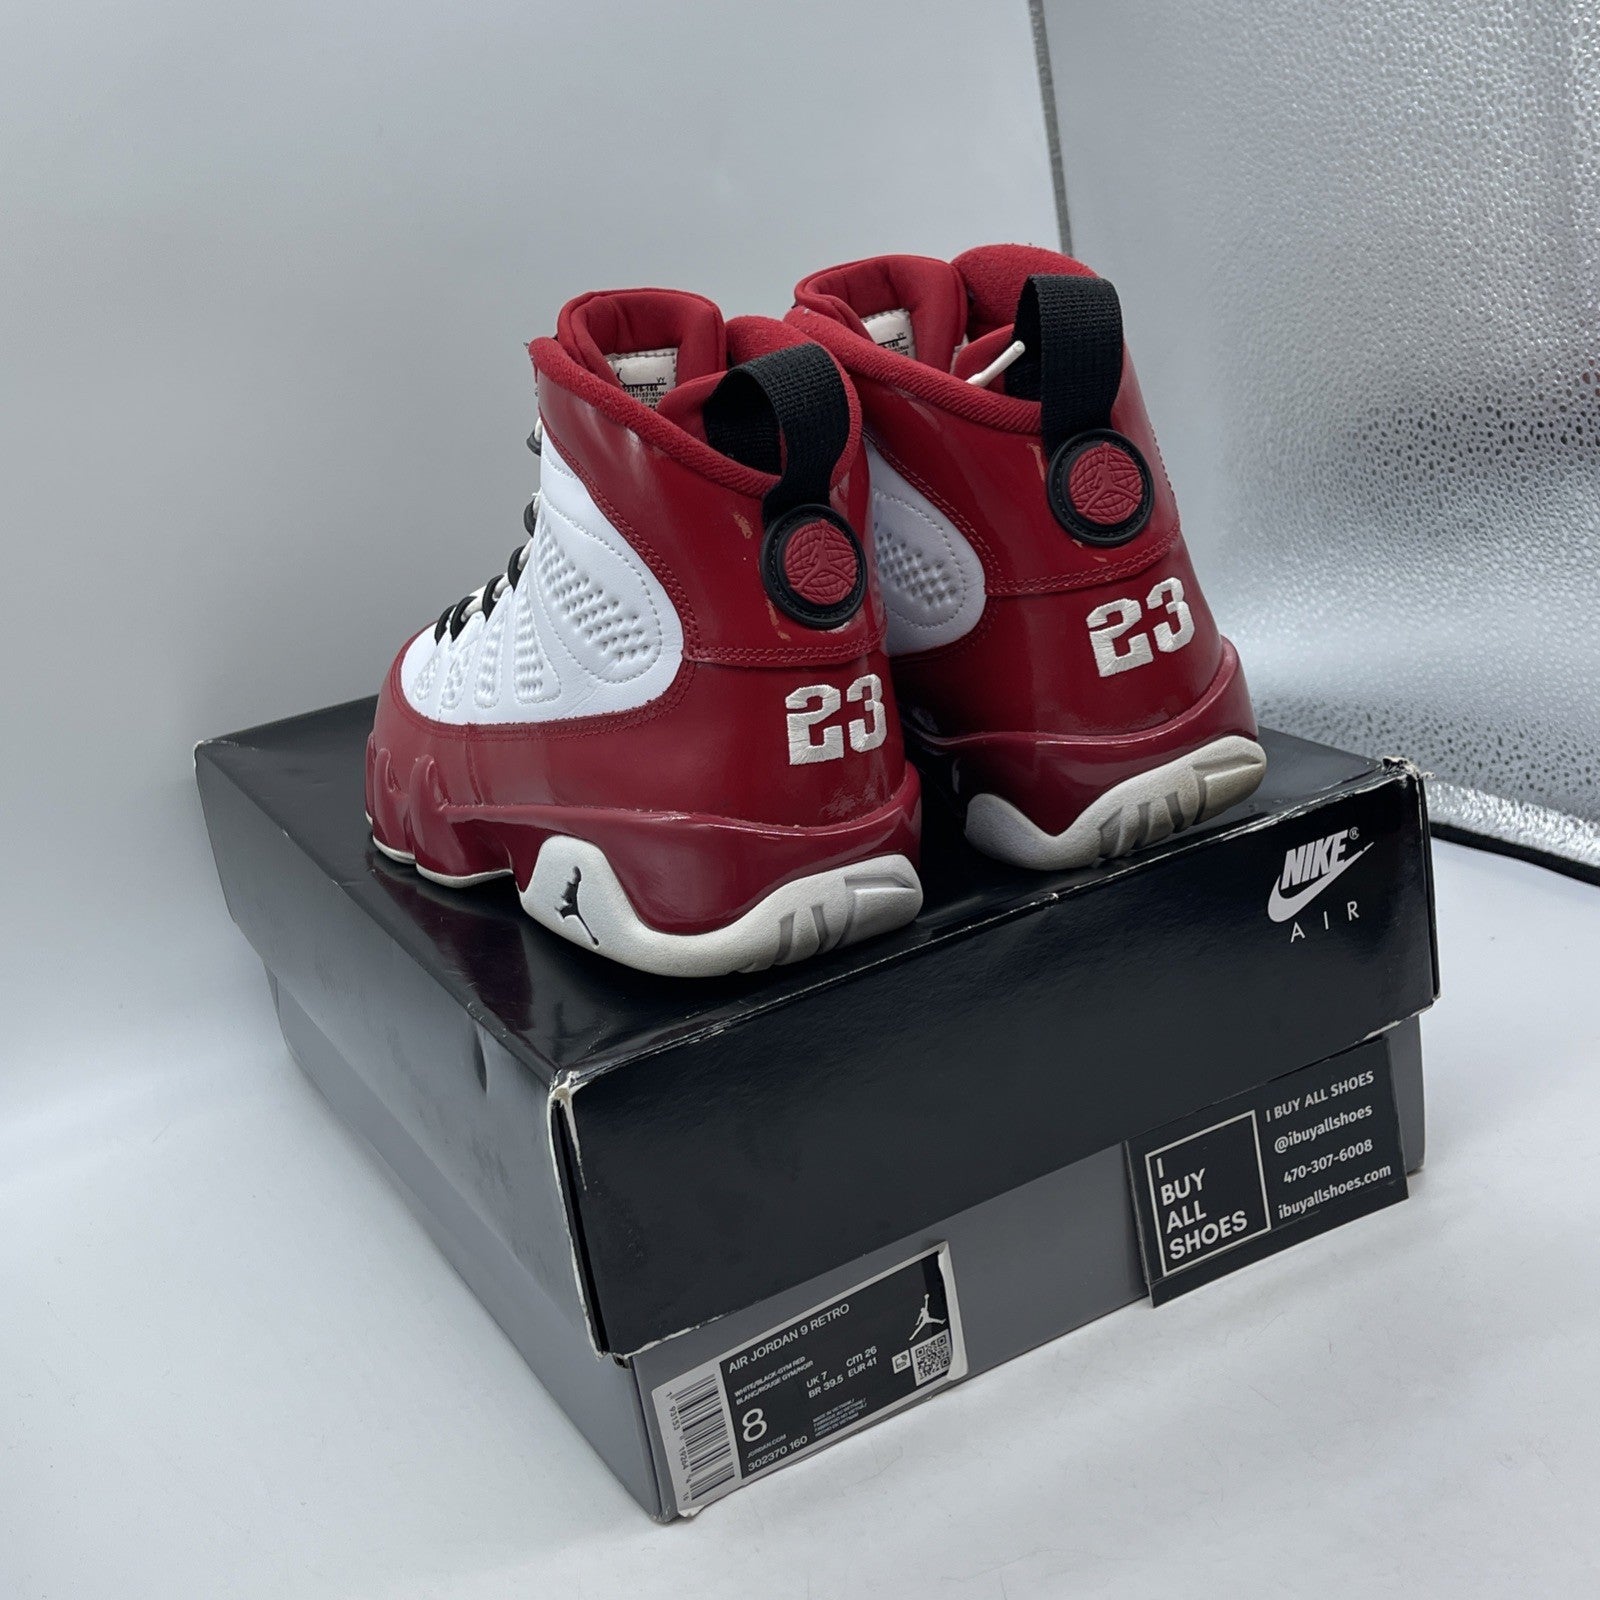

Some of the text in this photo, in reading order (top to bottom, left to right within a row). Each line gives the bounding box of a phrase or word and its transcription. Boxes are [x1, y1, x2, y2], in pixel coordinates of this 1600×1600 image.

[1085, 577, 1195, 678] 23
[785, 673, 888, 766] 23
[1280, 829, 1348, 890] NIKE
[1290, 900, 1360, 943] AIR
[1265, 1070, 1375, 1123] I BUY ALL SHOES
[1274, 1104, 1373, 1155] @ibuyallshoes
[1156, 1157, 1164, 1179] I
[1283, 1138, 1373, 1184] 470-307-6008
[1160, 1168, 1206, 1206] BUY
[1278, 1164, 1392, 1220] ibuyallshoes.com
[1166, 1200, 1207, 1234] ALL
[1169, 1210, 1248, 1260] SHOES
[729, 1303, 850, 1374] AIR JORDAN 9 RETRO
[845, 1346, 878, 1367] cm 26
[792, 1356, 806, 1368] RED
[806, 1371, 828, 1388] UK 7
[847, 1357, 877, 1378] EUR 41
[808, 1374, 844, 1399] BR 39.5
[742, 1408, 768, 1443] 8
[747, 1434, 787, 1458] JORDAN.COM
[748, 1435, 808, 1472] 302370 160
